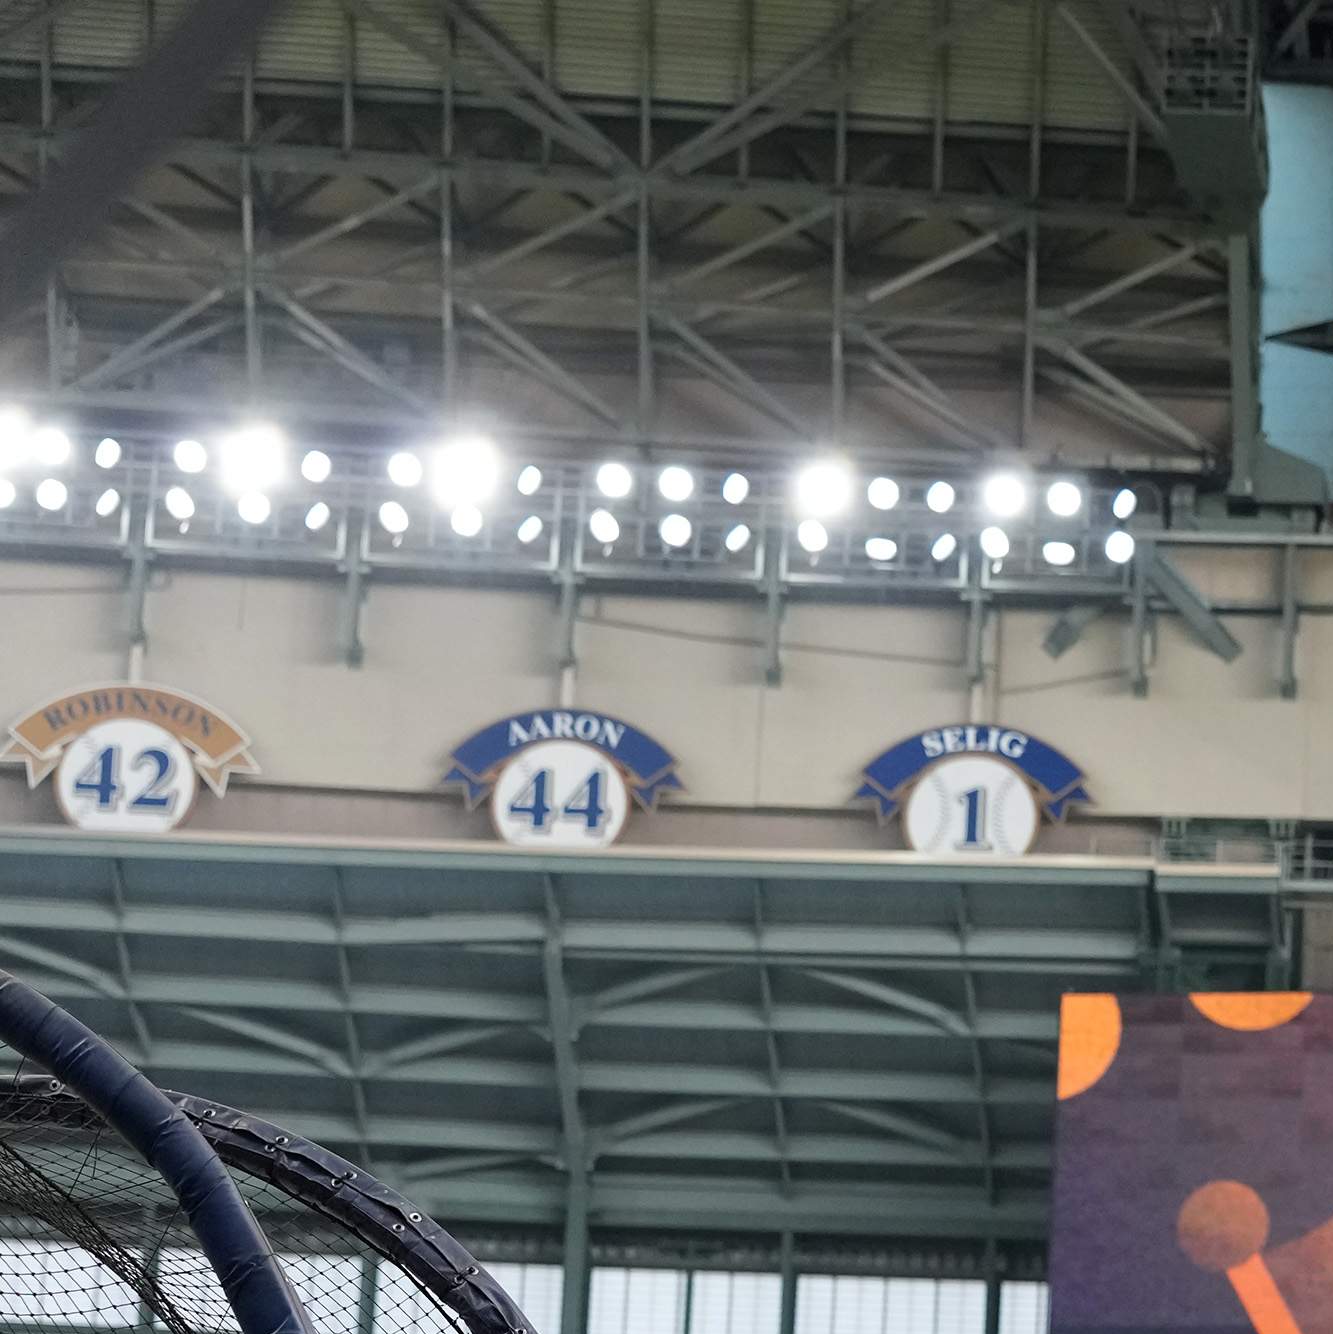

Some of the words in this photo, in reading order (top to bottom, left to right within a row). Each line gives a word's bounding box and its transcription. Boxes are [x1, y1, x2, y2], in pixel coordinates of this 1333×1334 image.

[44, 689, 216, 739] ROBINSON
[507, 714, 626, 750] AARON
[921, 726, 1028, 759] SELIG
[74, 744, 181, 812] 42
[509, 767, 608, 837] 44
[955, 784, 993, 851] 1
